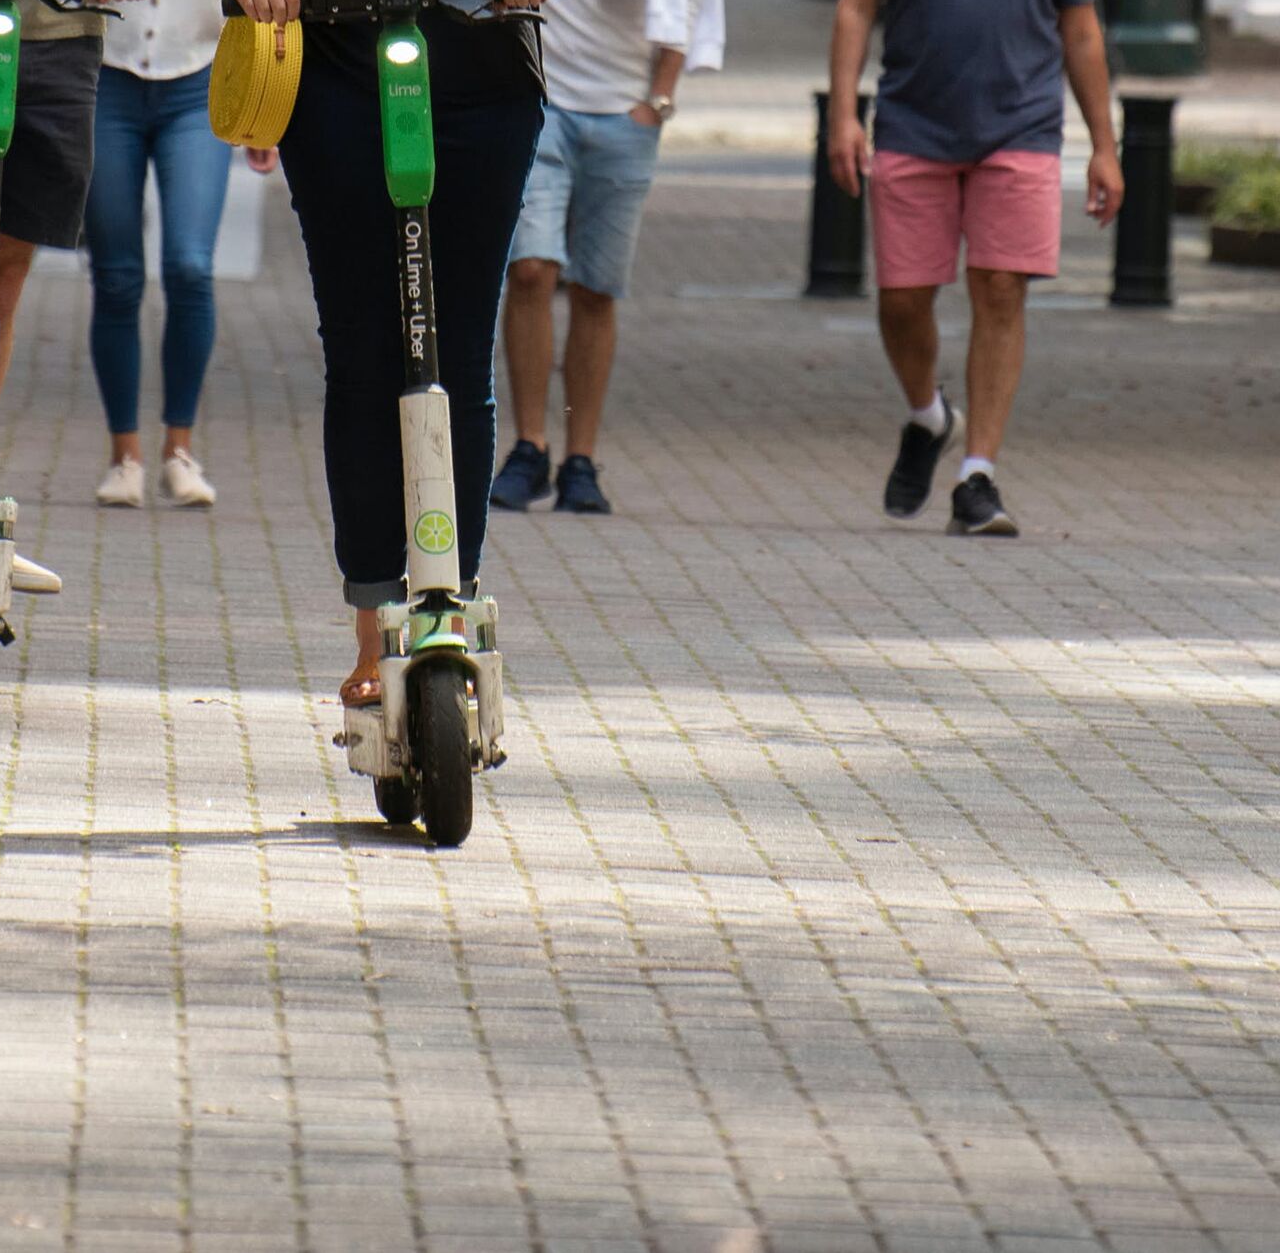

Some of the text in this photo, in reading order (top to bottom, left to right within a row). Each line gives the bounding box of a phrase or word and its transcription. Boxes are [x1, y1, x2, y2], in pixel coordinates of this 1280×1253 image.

[389, 83, 422, 96] Lime
[405, 221, 422, 250] On
[406, 253, 423, 298] Lime
[409, 315, 427, 361] Uber
